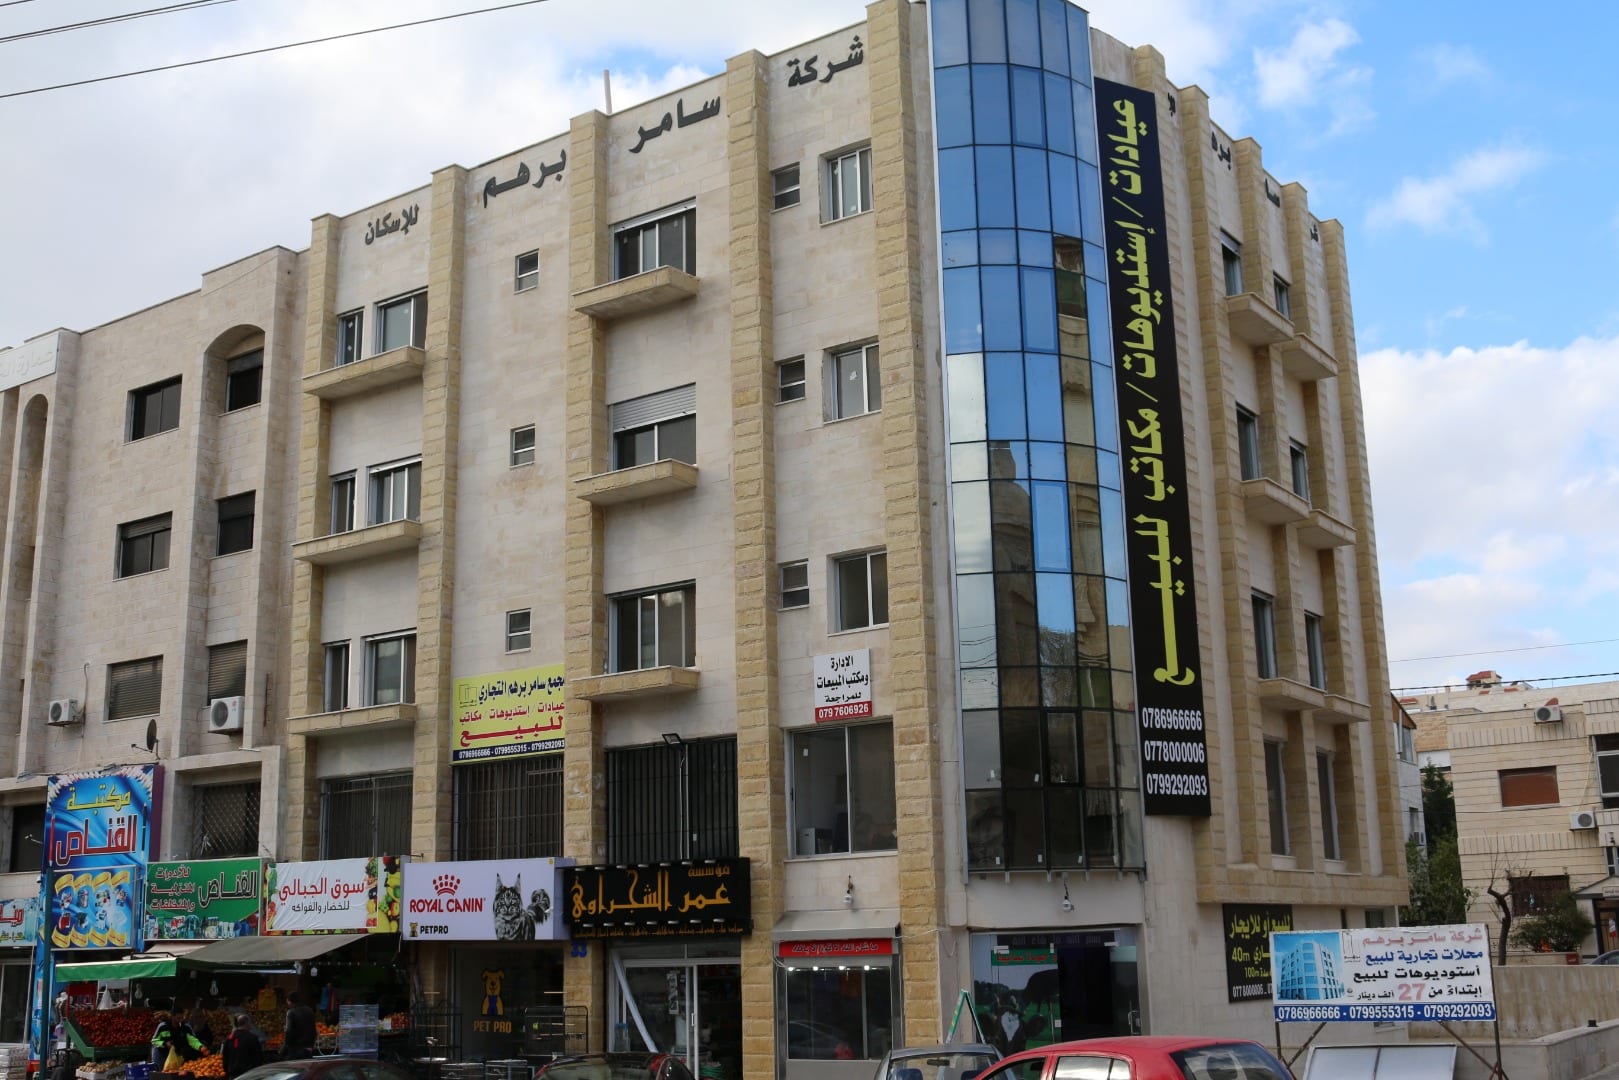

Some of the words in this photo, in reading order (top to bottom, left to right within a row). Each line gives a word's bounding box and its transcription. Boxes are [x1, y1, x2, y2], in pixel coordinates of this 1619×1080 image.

[788, 35, 864, 88] شركة
[629, 95, 720, 154] سامر
[1107, 99, 1148, 196] عيادات
[482, 148, 567, 208] برهم
[365, 203, 419, 245] للإسكان
[1126, 408, 1176, 502] مكاتب
[1133, 514, 1195, 686] للبيع
[528, 676, 546, 696] سامر
[816, 674, 844, 690] المبيعات
[846, 671, 868, 688] ومكتب
[479, 680, 506, 704] التجاري
[508, 680, 526, 698] برهم
[824, 692, 862, 703] للمراجعة
[538, 701, 565, 714] عيادات
[818, 708, 833, 718] 079
[834, 704, 868, 716] 7606926
[459, 711, 482, 726] مكاتب
[1142, 707, 1202, 731] 0786966666
[460, 715, 564, 747] للبيع
[1144, 740, 1205, 763] 0778000006
[1146, 773, 1208, 796] 0799292093
[66, 783, 131, 816] مكتبة
[56, 814, 138, 866] القناص
[688, 865, 730, 877] مؤسسة
[198, 870, 257, 908] القناص
[279, 877, 327, 905] الجبالي
[331, 880, 364, 899] سوق
[571, 869, 672, 922] الشجراوي
[678, 883, 731, 912] عمر
[292, 901, 321, 914] والفواكه
[323, 901, 350, 913] للخضار
[410, 899, 444, 913] ROYAL
[446, 898, 483, 912] CANIN
[420, 926, 449, 934] PETPRO
[1408, 932, 1446, 945] سامر
[1450, 928, 1482, 943] شركة
[1363, 936, 1404, 948] برهم
[1366, 951, 1394, 965] للبيع
[1398, 950, 1438, 963] تجارية
[1442, 949, 1483, 959] محلات
[1354, 970, 1388, 983] للبيع
[1394, 965, 1480, 980] أستوديوهات
[1357, 992, 1376, 1000] دينار
[1398, 983, 1425, 1000] 27
[1429, 987, 1442, 998] من
[1278, 1006, 1340, 1020] 0786966666
[1350, 1005, 1414, 1018] 0799555315
[1424, 1004, 1492, 1018] 0799292093
[473, 1020, 490, 1032] PET
[494, 1021, 512, 1033] PRO
